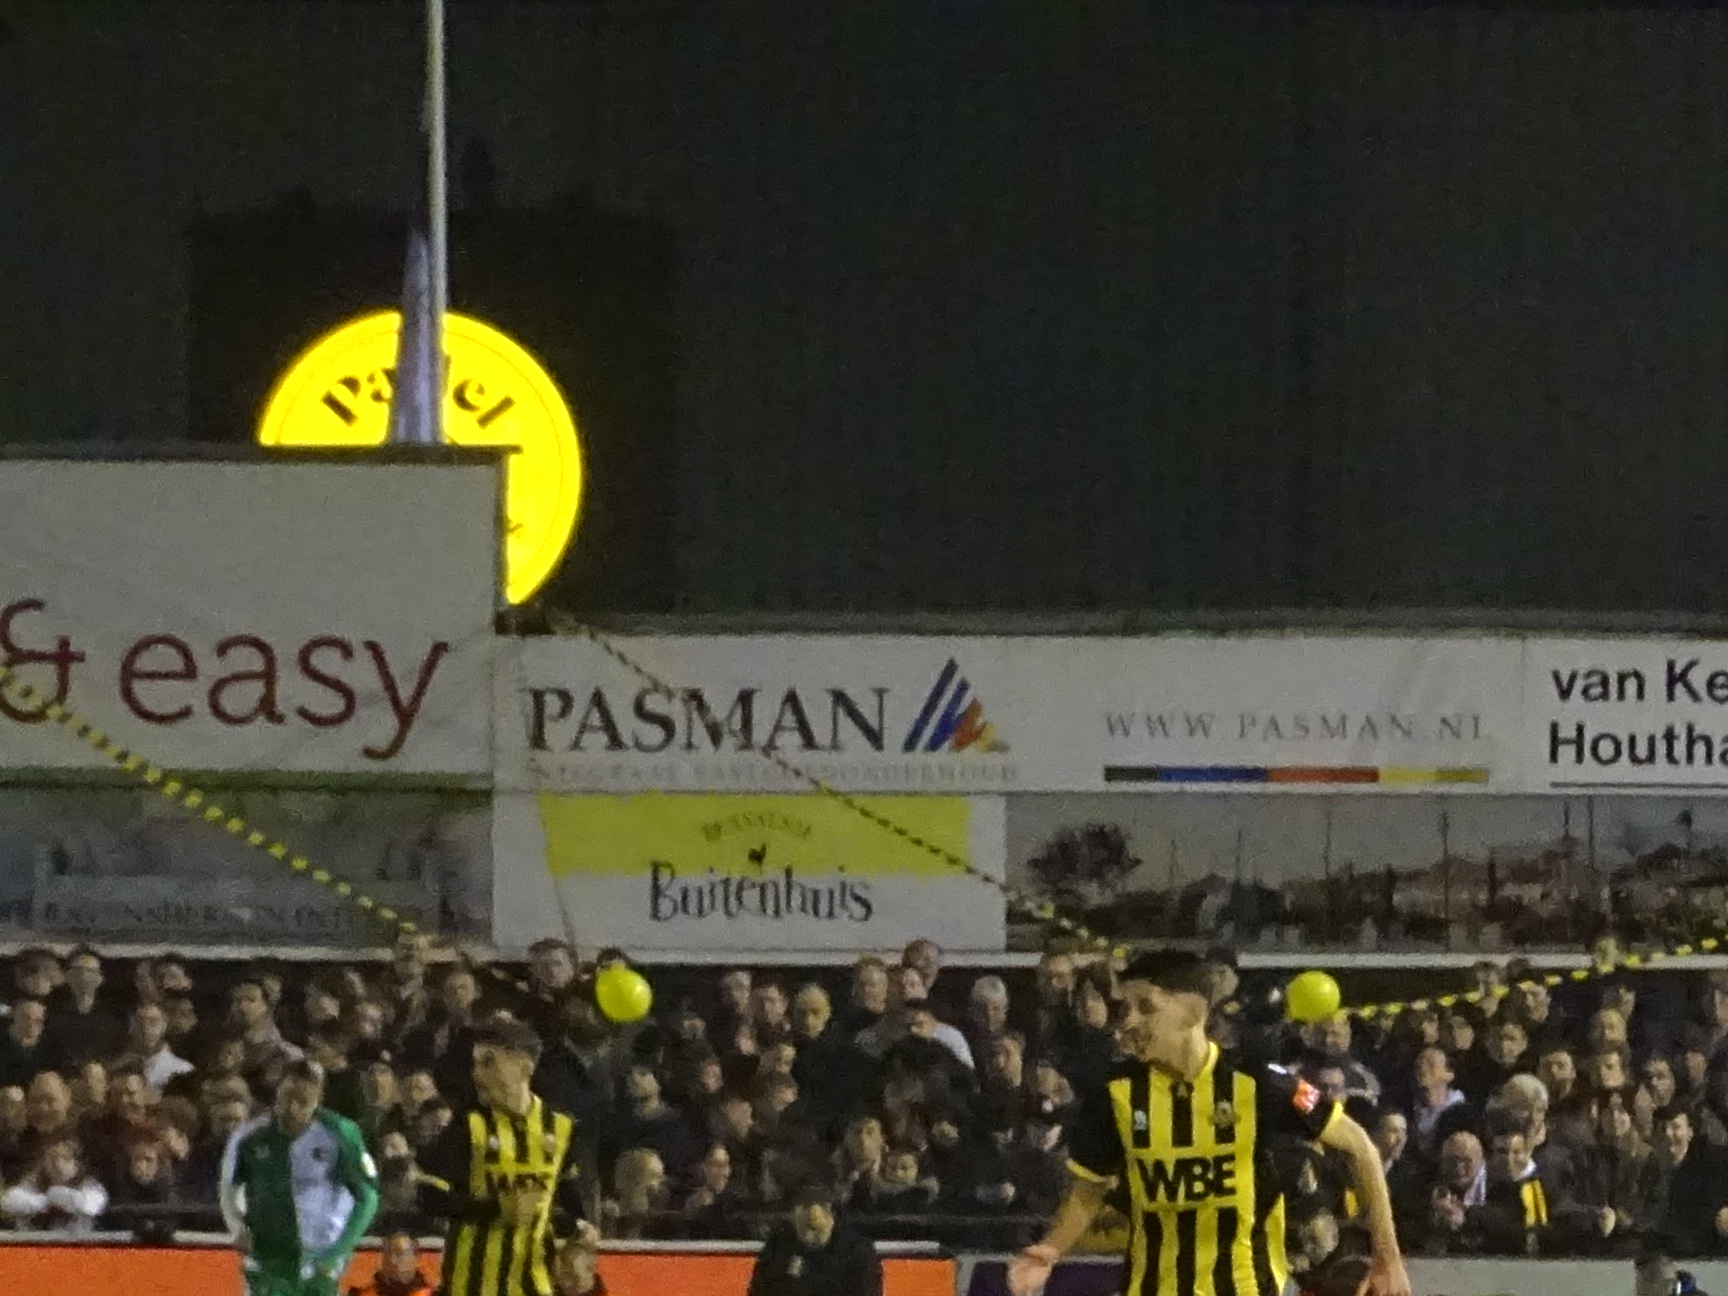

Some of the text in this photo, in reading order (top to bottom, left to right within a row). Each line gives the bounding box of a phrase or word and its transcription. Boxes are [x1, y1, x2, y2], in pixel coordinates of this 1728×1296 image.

[118, 632, 449, 762] easy
[1552, 668, 1645, 702] van
[528, 686, 892, 753] PASMAN
[649, 860, 874, 922] Buitenhuis
[1135, 1154, 1236, 1203] WBE
